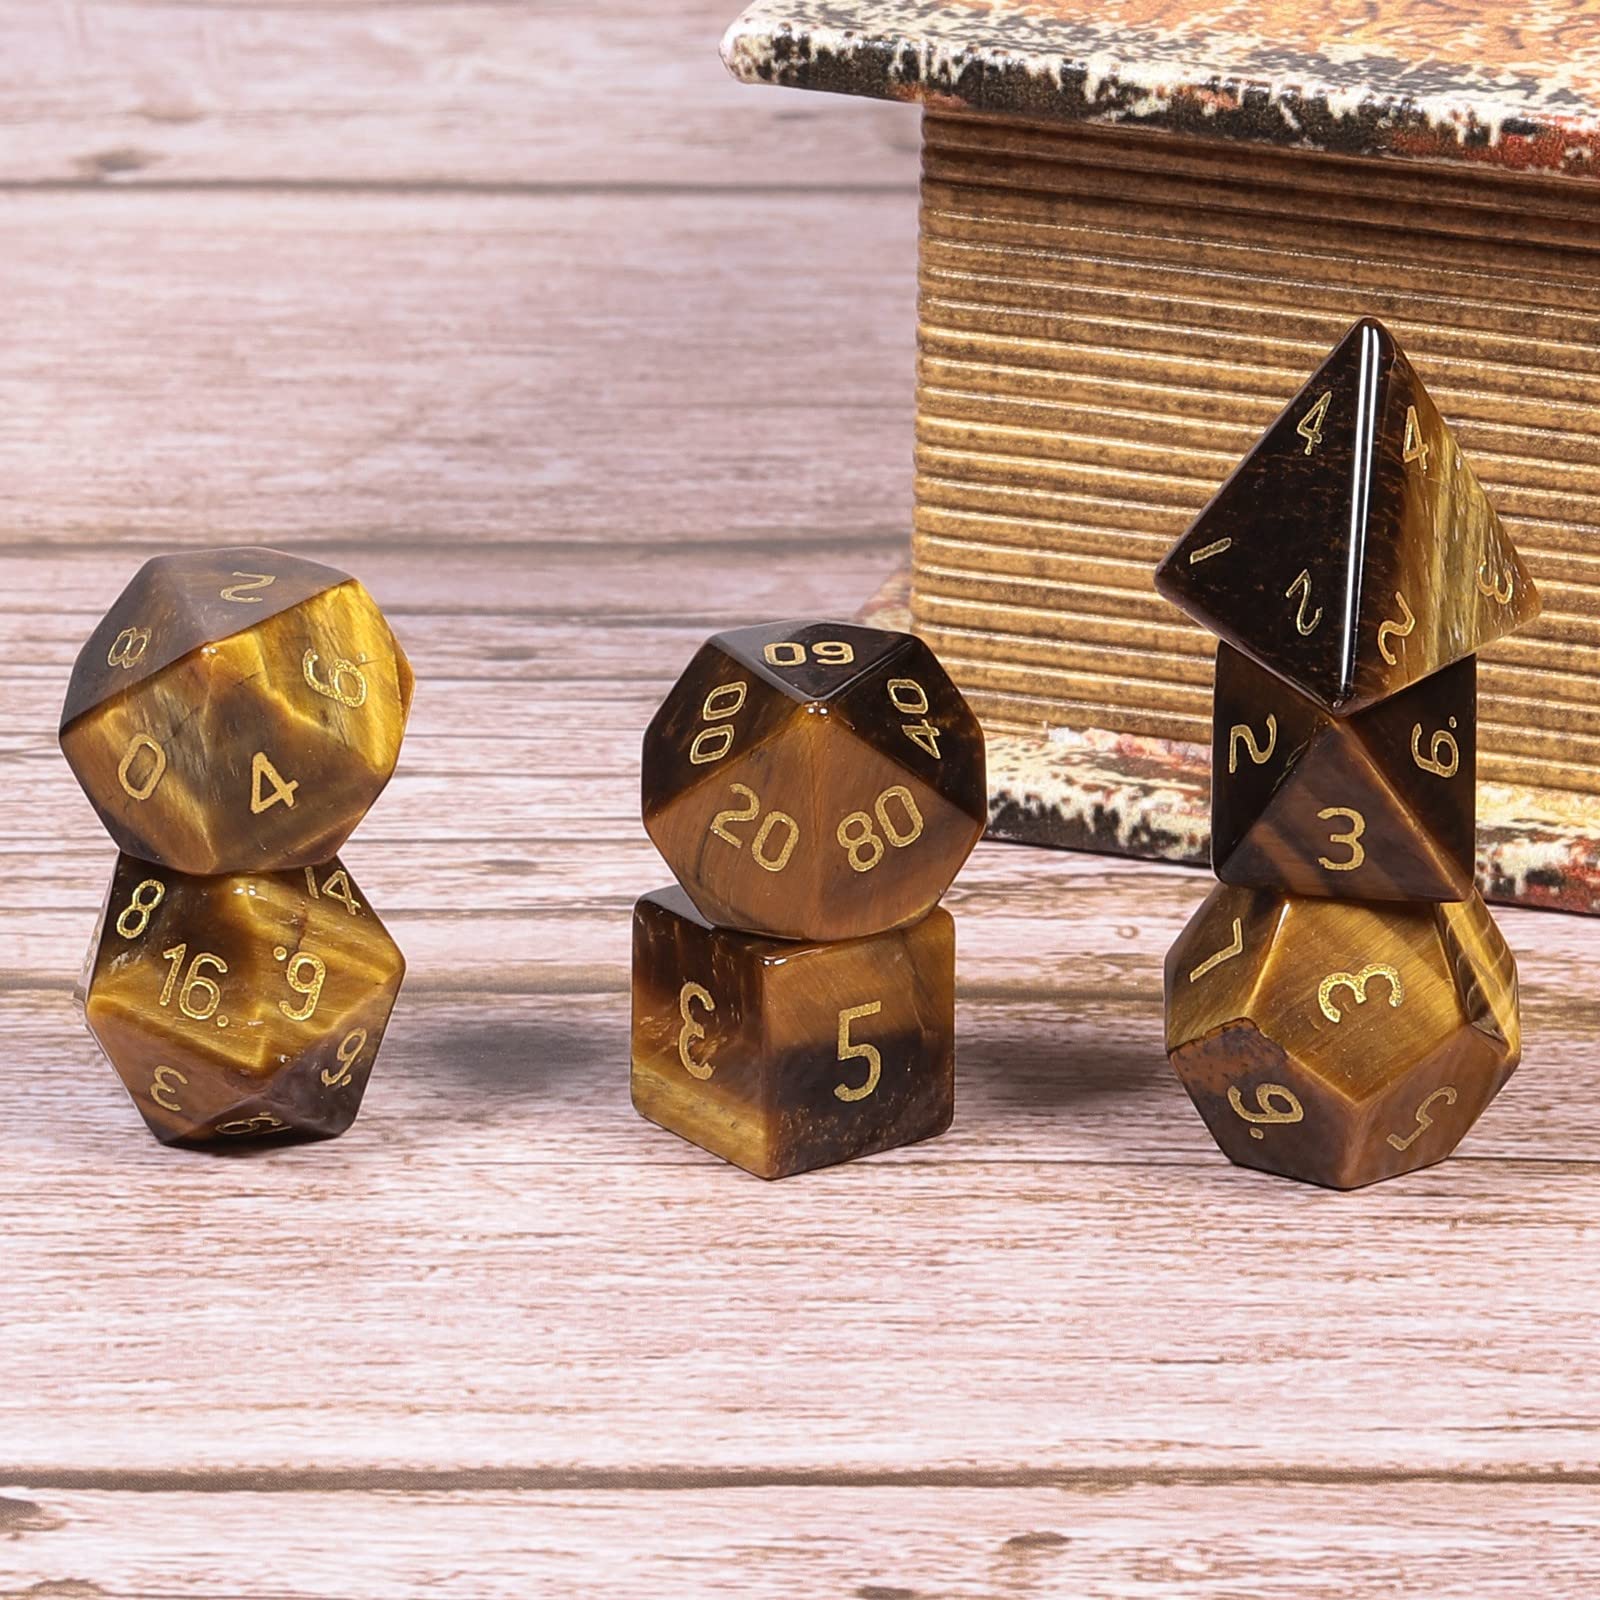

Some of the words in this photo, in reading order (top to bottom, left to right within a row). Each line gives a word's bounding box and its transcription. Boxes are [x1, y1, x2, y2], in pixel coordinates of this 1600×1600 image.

[1297, 391, 1332, 455] 4
[1403, 405, 1429, 471] 4
[220, 571, 276, 603] 2
[1285, 569, 1323, 636] 2
[1476, 560, 1513, 605] 3
[107, 627, 151, 669] 8
[1378, 591, 1416, 666] 2
[689, 681, 748, 765] 00
[887, 679, 941, 759] 40
[1228, 712, 1278, 774] 2
[118, 733, 166, 800] 0
[250, 752, 299, 814] 4
[710, 783, 800, 872] 20
[836, 785, 924, 872] 80
[1316, 807, 1366, 871] 3
[116, 879, 165, 939] 8
[304, 866, 361, 915] 14
[1318, 962, 1403, 1024] 3
[679, 981, 716, 1080] 3
[833, 1000, 881, 1102] 5
[149, 1064, 188, 1112] 3
[1387, 1086, 1457, 1151] 5
